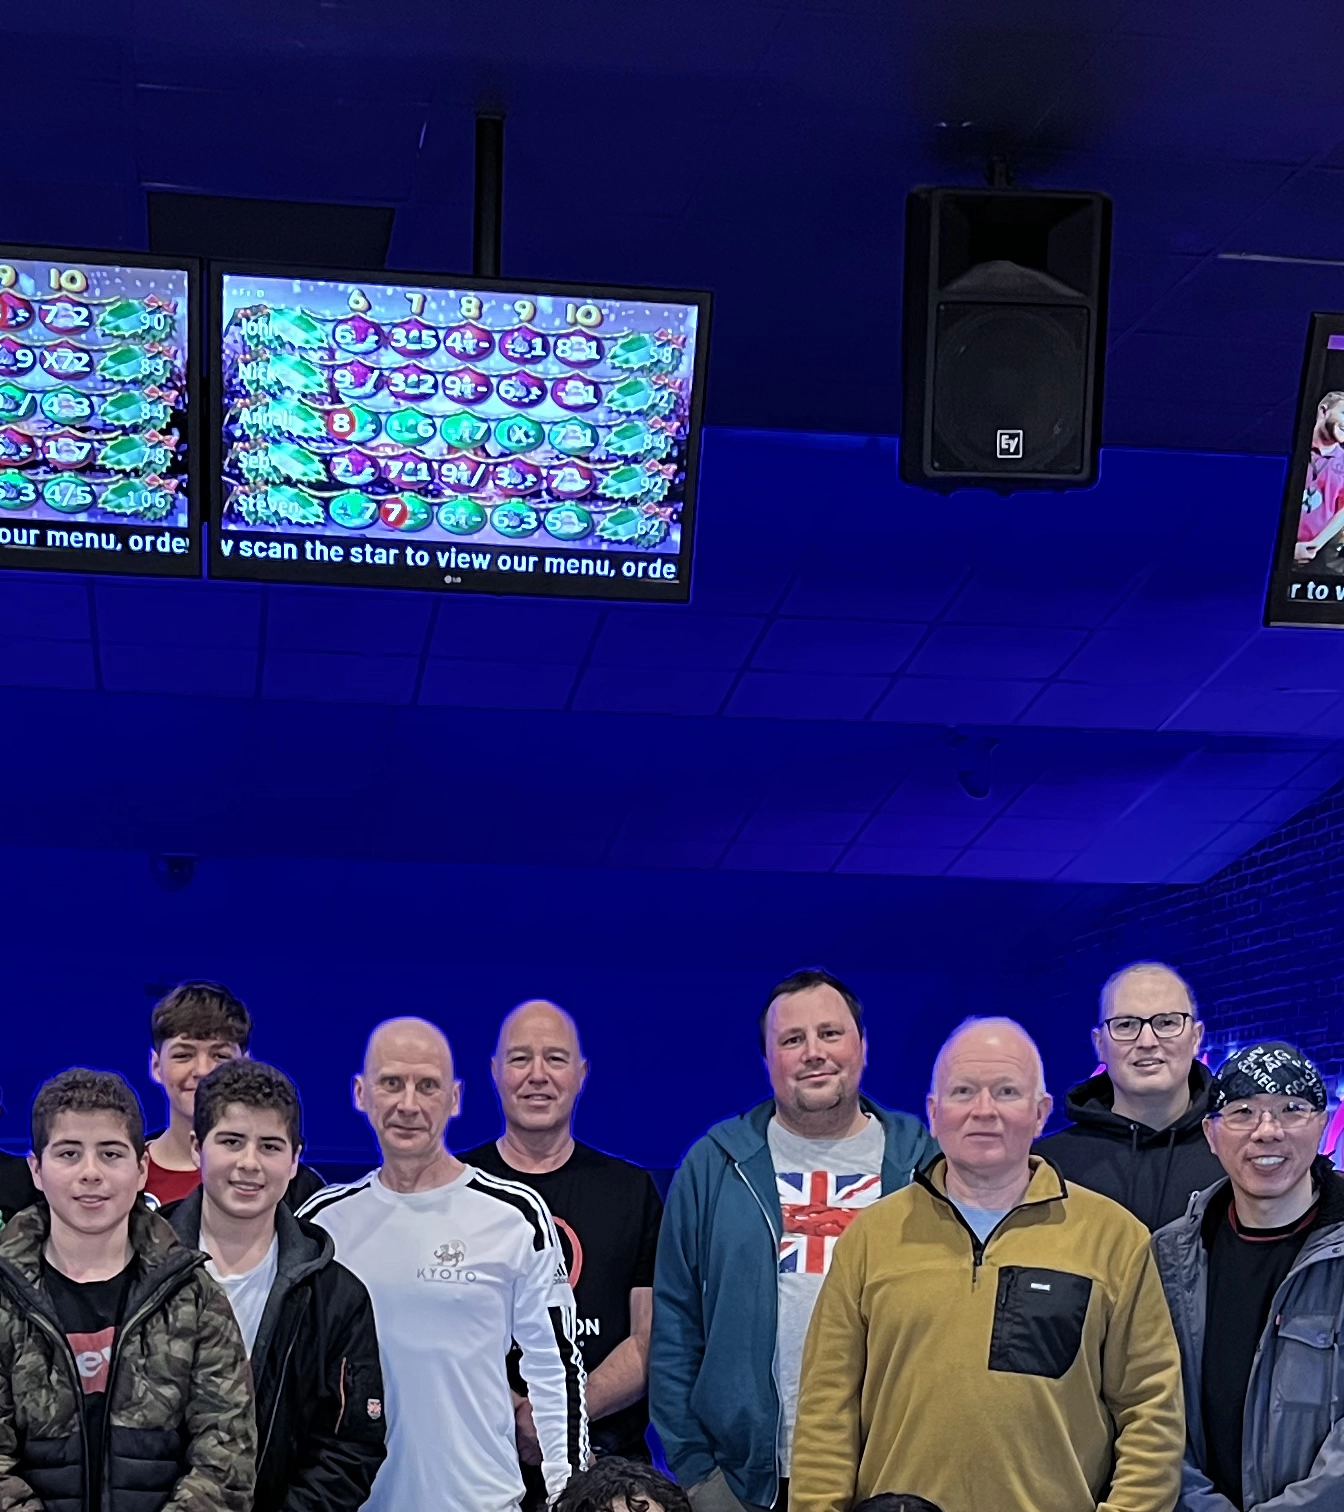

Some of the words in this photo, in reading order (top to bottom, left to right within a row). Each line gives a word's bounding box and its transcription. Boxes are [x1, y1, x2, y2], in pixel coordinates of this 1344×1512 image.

[50, 269, 87, 292] 10
[348, 289, 369, 312] 6
[460, 296, 481, 320] 8
[514, 300, 534, 322] 9
[566, 304, 601, 326] 10
[238, 496, 300, 513] Steven
[47, 531, 122, 551] menu,
[129, 532, 189, 553] orde
[240, 540, 298, 560] scan
[305, 540, 344, 562] the
[350, 544, 399, 565] star
[406, 546, 429, 566] to
[436, 546, 492, 569] view
[497, 555, 538, 571] our
[545, 556, 616, 577] menu,
[622, 558, 676, 578] orde
[1306, 581, 1329, 601] to
[416, 1267, 477, 1283] KYOTO
